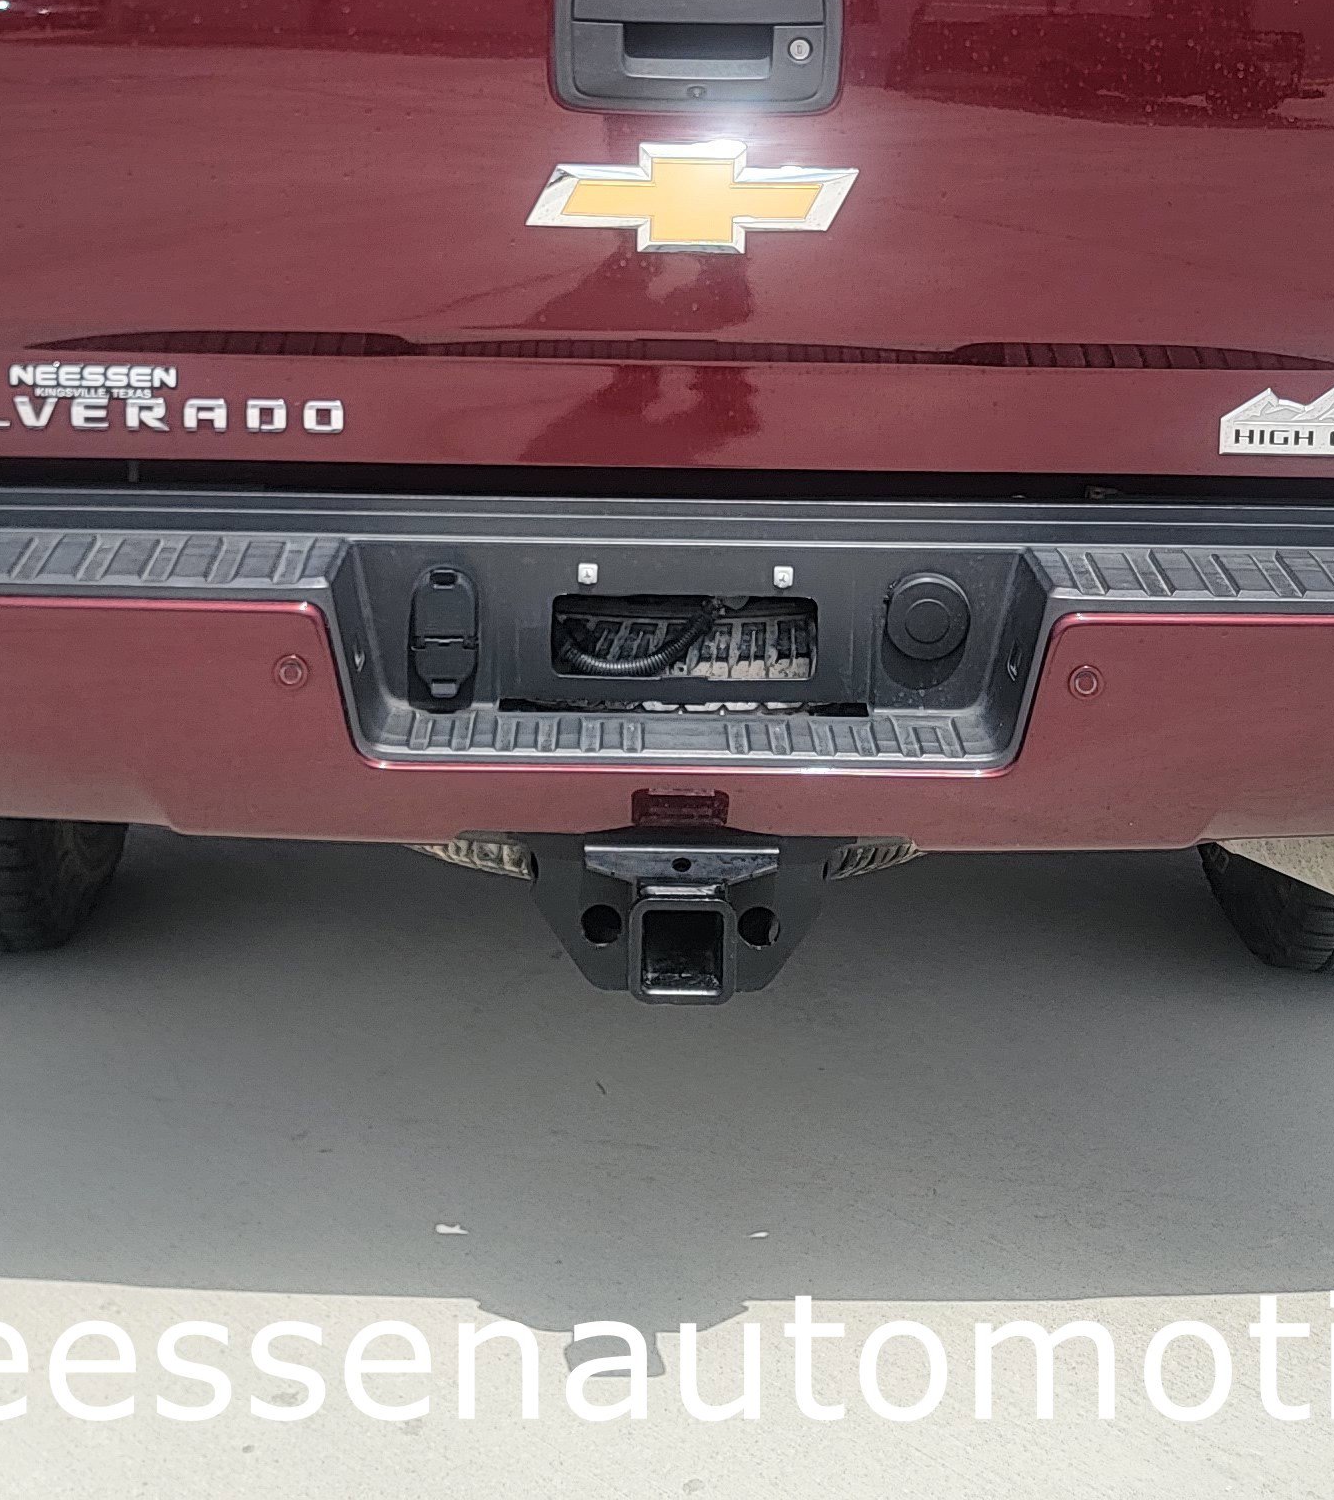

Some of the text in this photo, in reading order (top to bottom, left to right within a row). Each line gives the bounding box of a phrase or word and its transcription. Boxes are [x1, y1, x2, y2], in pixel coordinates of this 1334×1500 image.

[9, 363, 178, 389] NEESSEN
[34, 387, 152, 399] KINGSVILLE, TEXAS
[1233, 429, 1315, 446] HIGH
